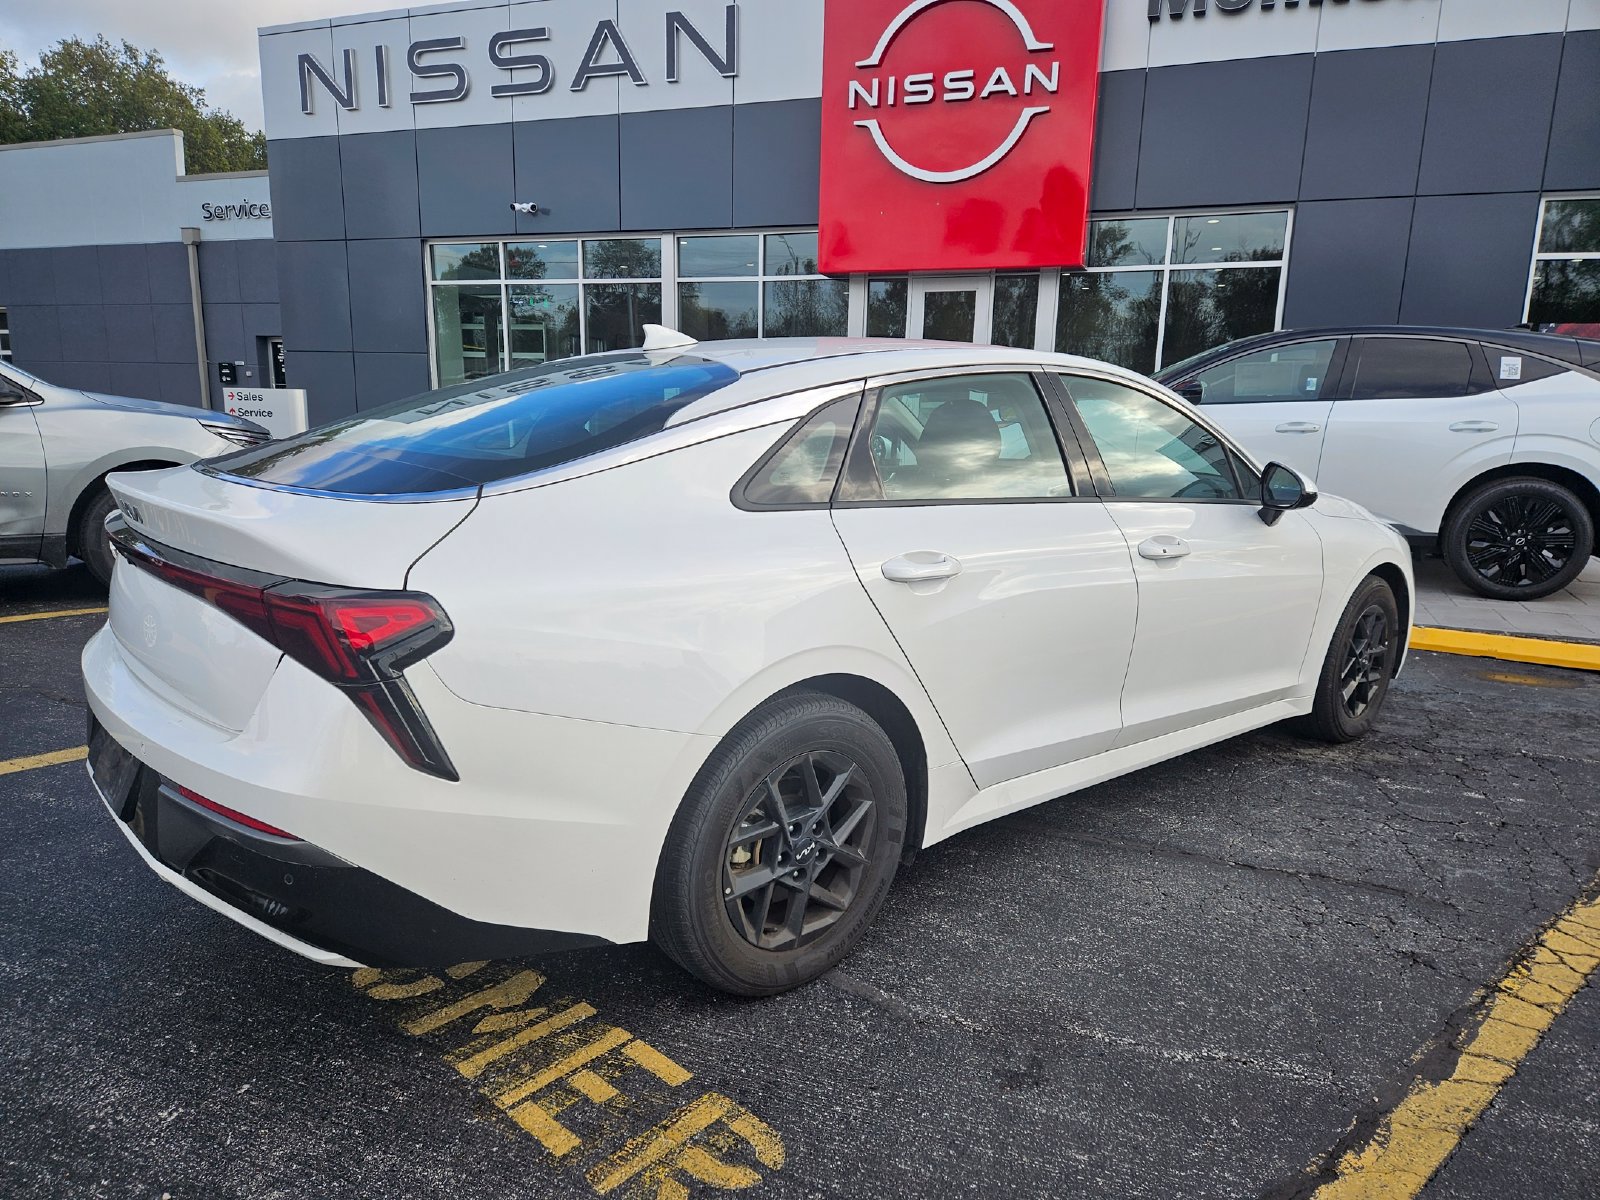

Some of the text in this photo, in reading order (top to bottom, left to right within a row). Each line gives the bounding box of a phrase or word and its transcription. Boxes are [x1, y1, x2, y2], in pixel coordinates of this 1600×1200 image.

[297, 3, 738, 114] NISSAN
[848, 61, 1060, 109] NISSAN
[201, 199, 271, 221] Service
[236, 391, 264, 402] Sales
[237, 407, 273, 418] Service
